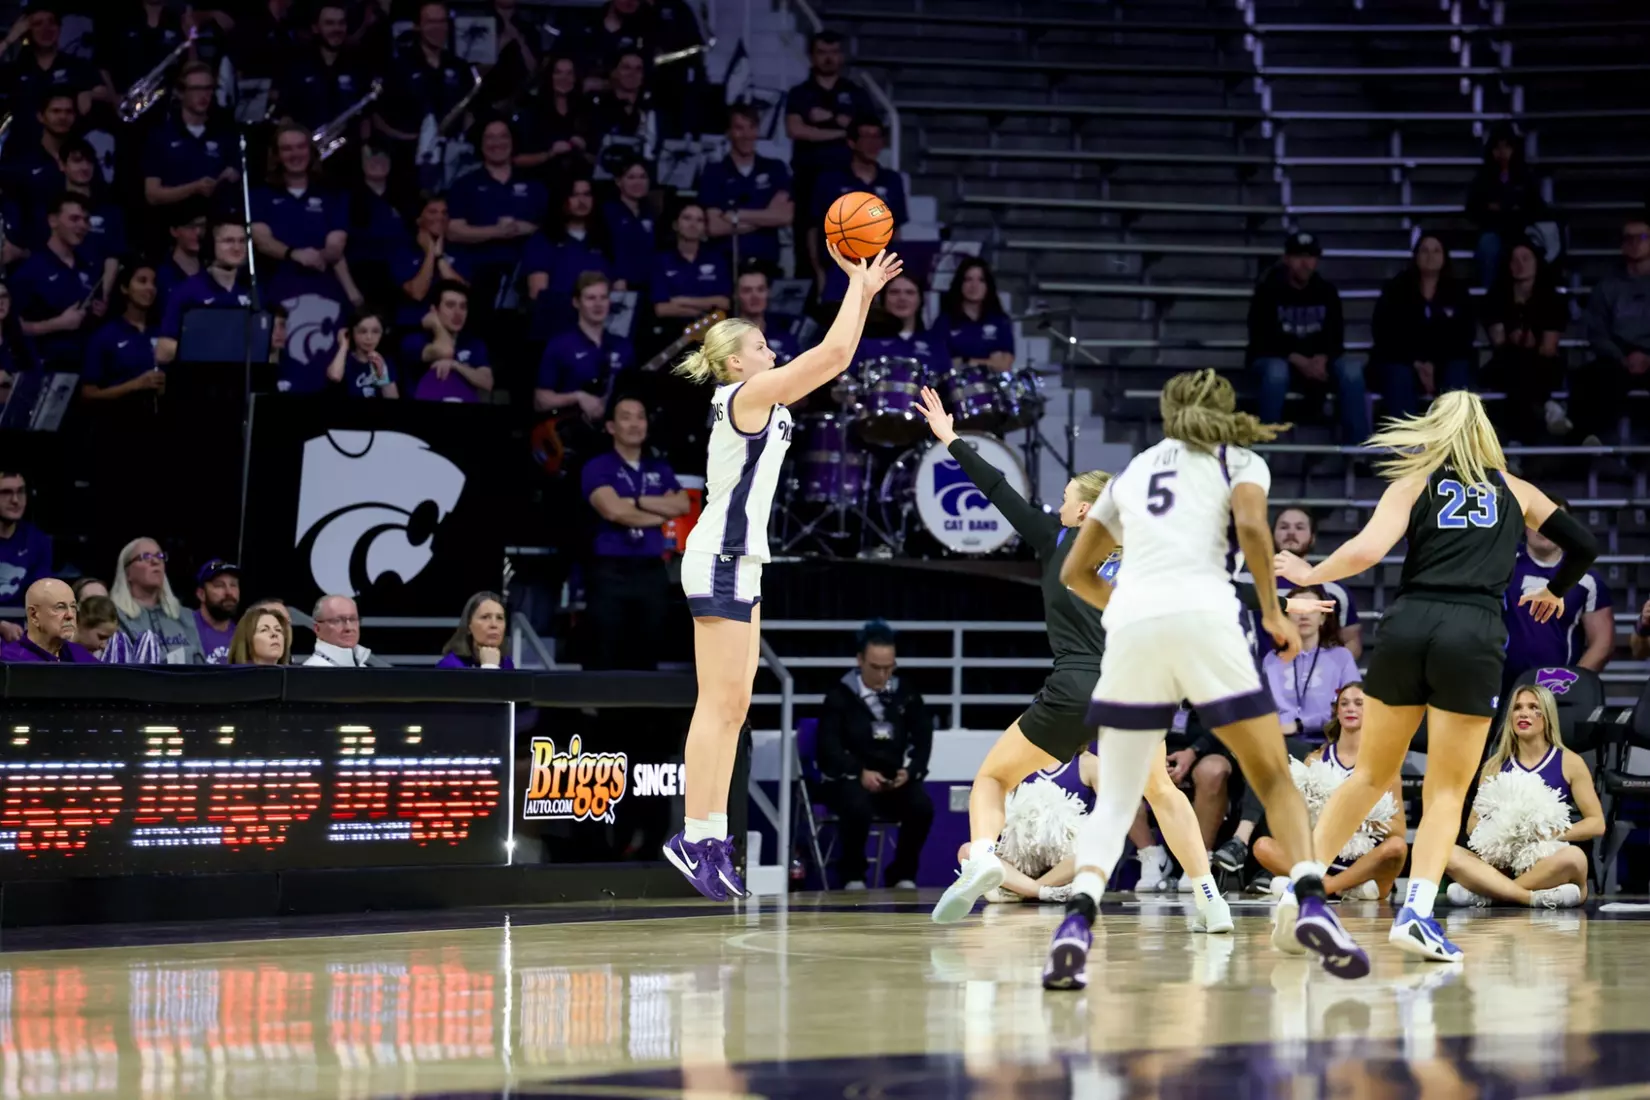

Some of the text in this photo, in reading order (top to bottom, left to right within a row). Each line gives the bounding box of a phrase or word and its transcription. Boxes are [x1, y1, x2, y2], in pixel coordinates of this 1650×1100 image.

[1146, 469, 1178, 518] 5
[1437, 478, 1498, 529] 23
[944, 520, 998, 532] CAT BAND
[527, 736, 627, 817] Briggs
[632, 763, 677, 797] SINCE
[526, 799, 575, 814] AUTO.COM
